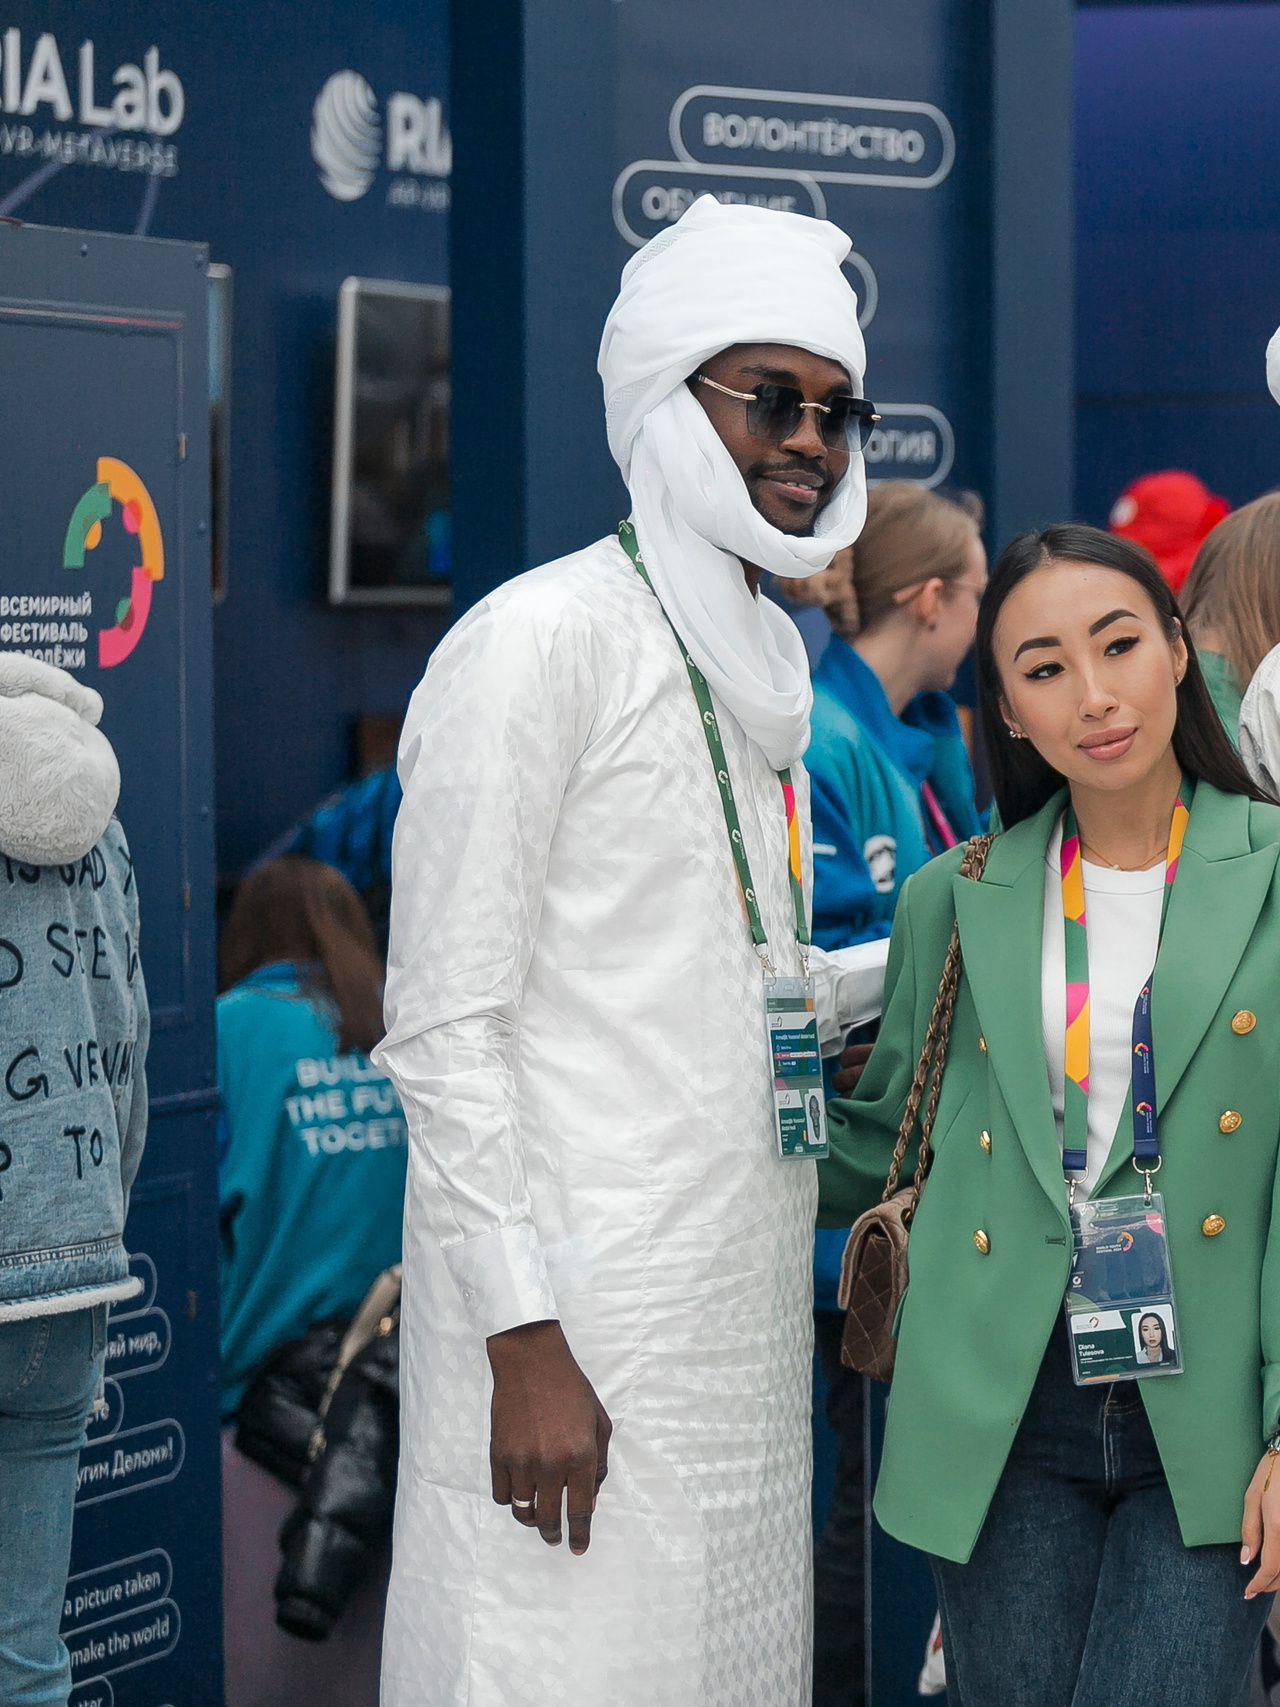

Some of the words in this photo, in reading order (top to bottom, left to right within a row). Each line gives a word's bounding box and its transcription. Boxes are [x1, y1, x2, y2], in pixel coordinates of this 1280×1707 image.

[0, 26, 74, 122] IA
[79, 39, 186, 136] Lab
[0, 591, 92, 617] ВСЕМИРНЫЙ
[0, 621, 88, 644] ФЕСТИВАЛЬ
[285, 1089, 348, 1126] THE
[63, 1125, 104, 1180] TO
[1078, 1343, 1095, 1351] Diana
[76, 1461, 109, 1492] угим
[75, 1584, 122, 1618] picture
[125, 1571, 161, 1597] taken
[70, 1639, 105, 1668] make
[108, 1632, 130, 1656] the
[133, 1614, 170, 1647] world
